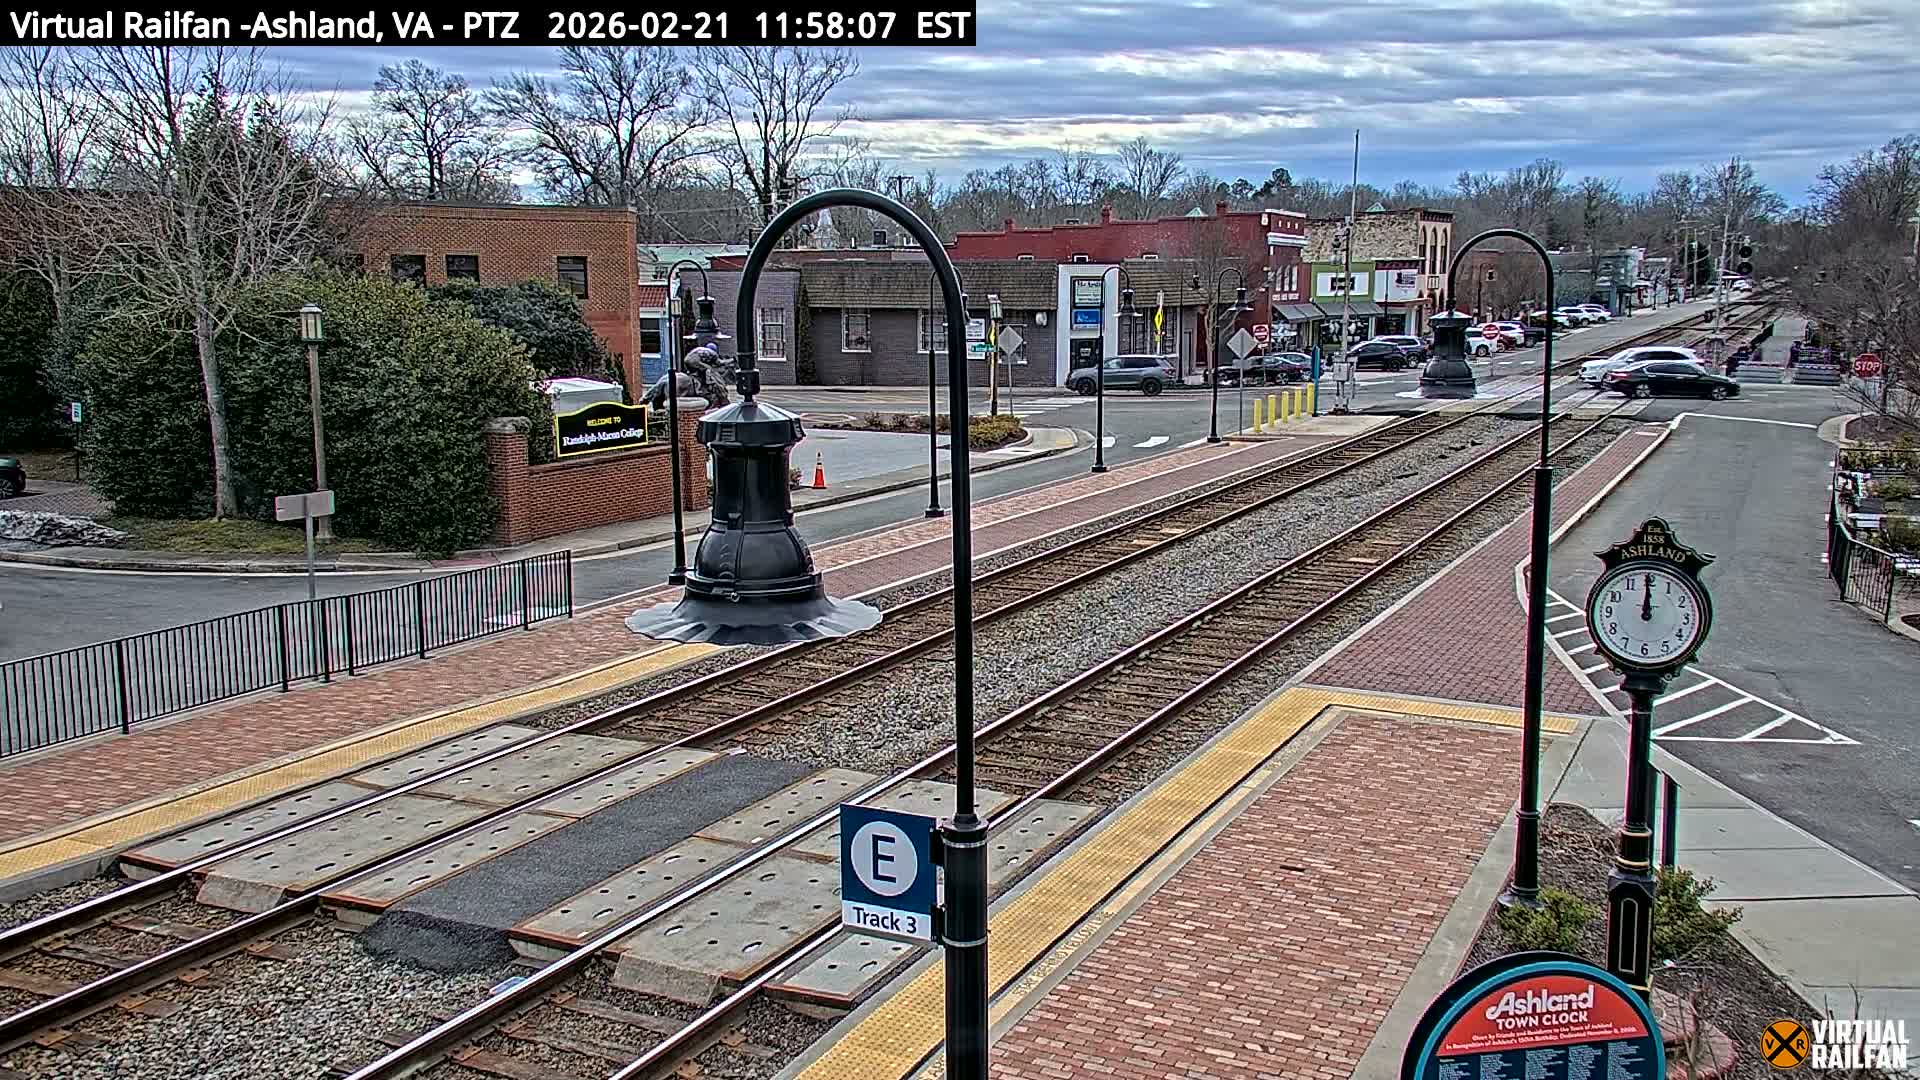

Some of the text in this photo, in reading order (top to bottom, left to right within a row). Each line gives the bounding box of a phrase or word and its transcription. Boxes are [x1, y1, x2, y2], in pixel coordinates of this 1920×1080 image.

[1855, 361, 1880, 371] STOP
[562, 431, 620, 446] Randolph-Macon
[1643, 534, 1665, 544] 1858
[1621, 545, 1686, 563] ASHLAND
[1626, 578, 1635, 591] 11
[1666, 582, 1671, 594] 1
[1609, 591, 1621, 603] 10
[1678, 596, 1686, 608] 2
[1605, 606, 1613, 618] 9
[1682, 613, 1690, 625] 3
[1609, 623, 1617, 635] 8
[1675, 629, 1683, 641] 4
[1621, 637, 1629, 649] 7
[1661, 641, 1669, 652] 5
[1641, 644, 1648, 656] 6
[872, 834, 897, 883] E
[853, 906, 917, 934] Track 3
[1485, 984, 1595, 1020] Ashland
[1496, 1011, 1588, 1030] TOWN CLOCK
